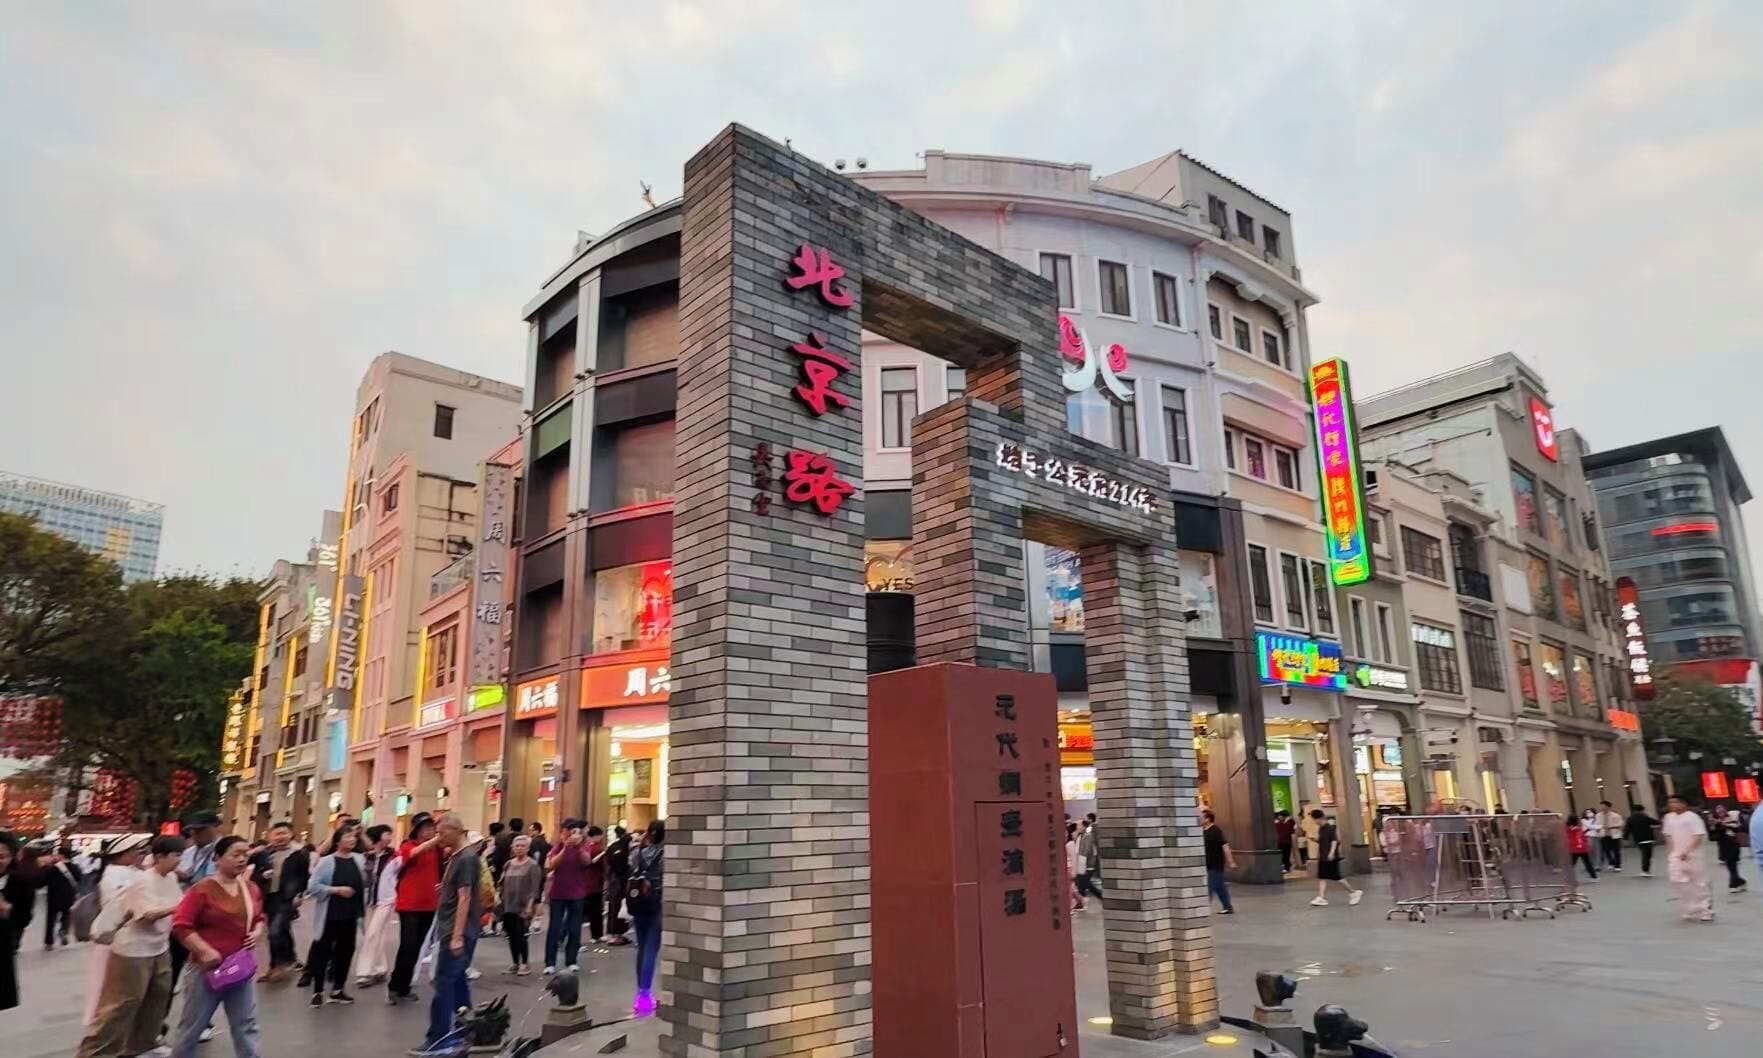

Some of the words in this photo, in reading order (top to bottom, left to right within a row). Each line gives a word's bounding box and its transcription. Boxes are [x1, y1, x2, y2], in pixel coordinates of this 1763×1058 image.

[783, 243, 856, 516] 北京路
[476, 522, 506, 624] 周六福
[518, 680, 559, 713] 周六福
